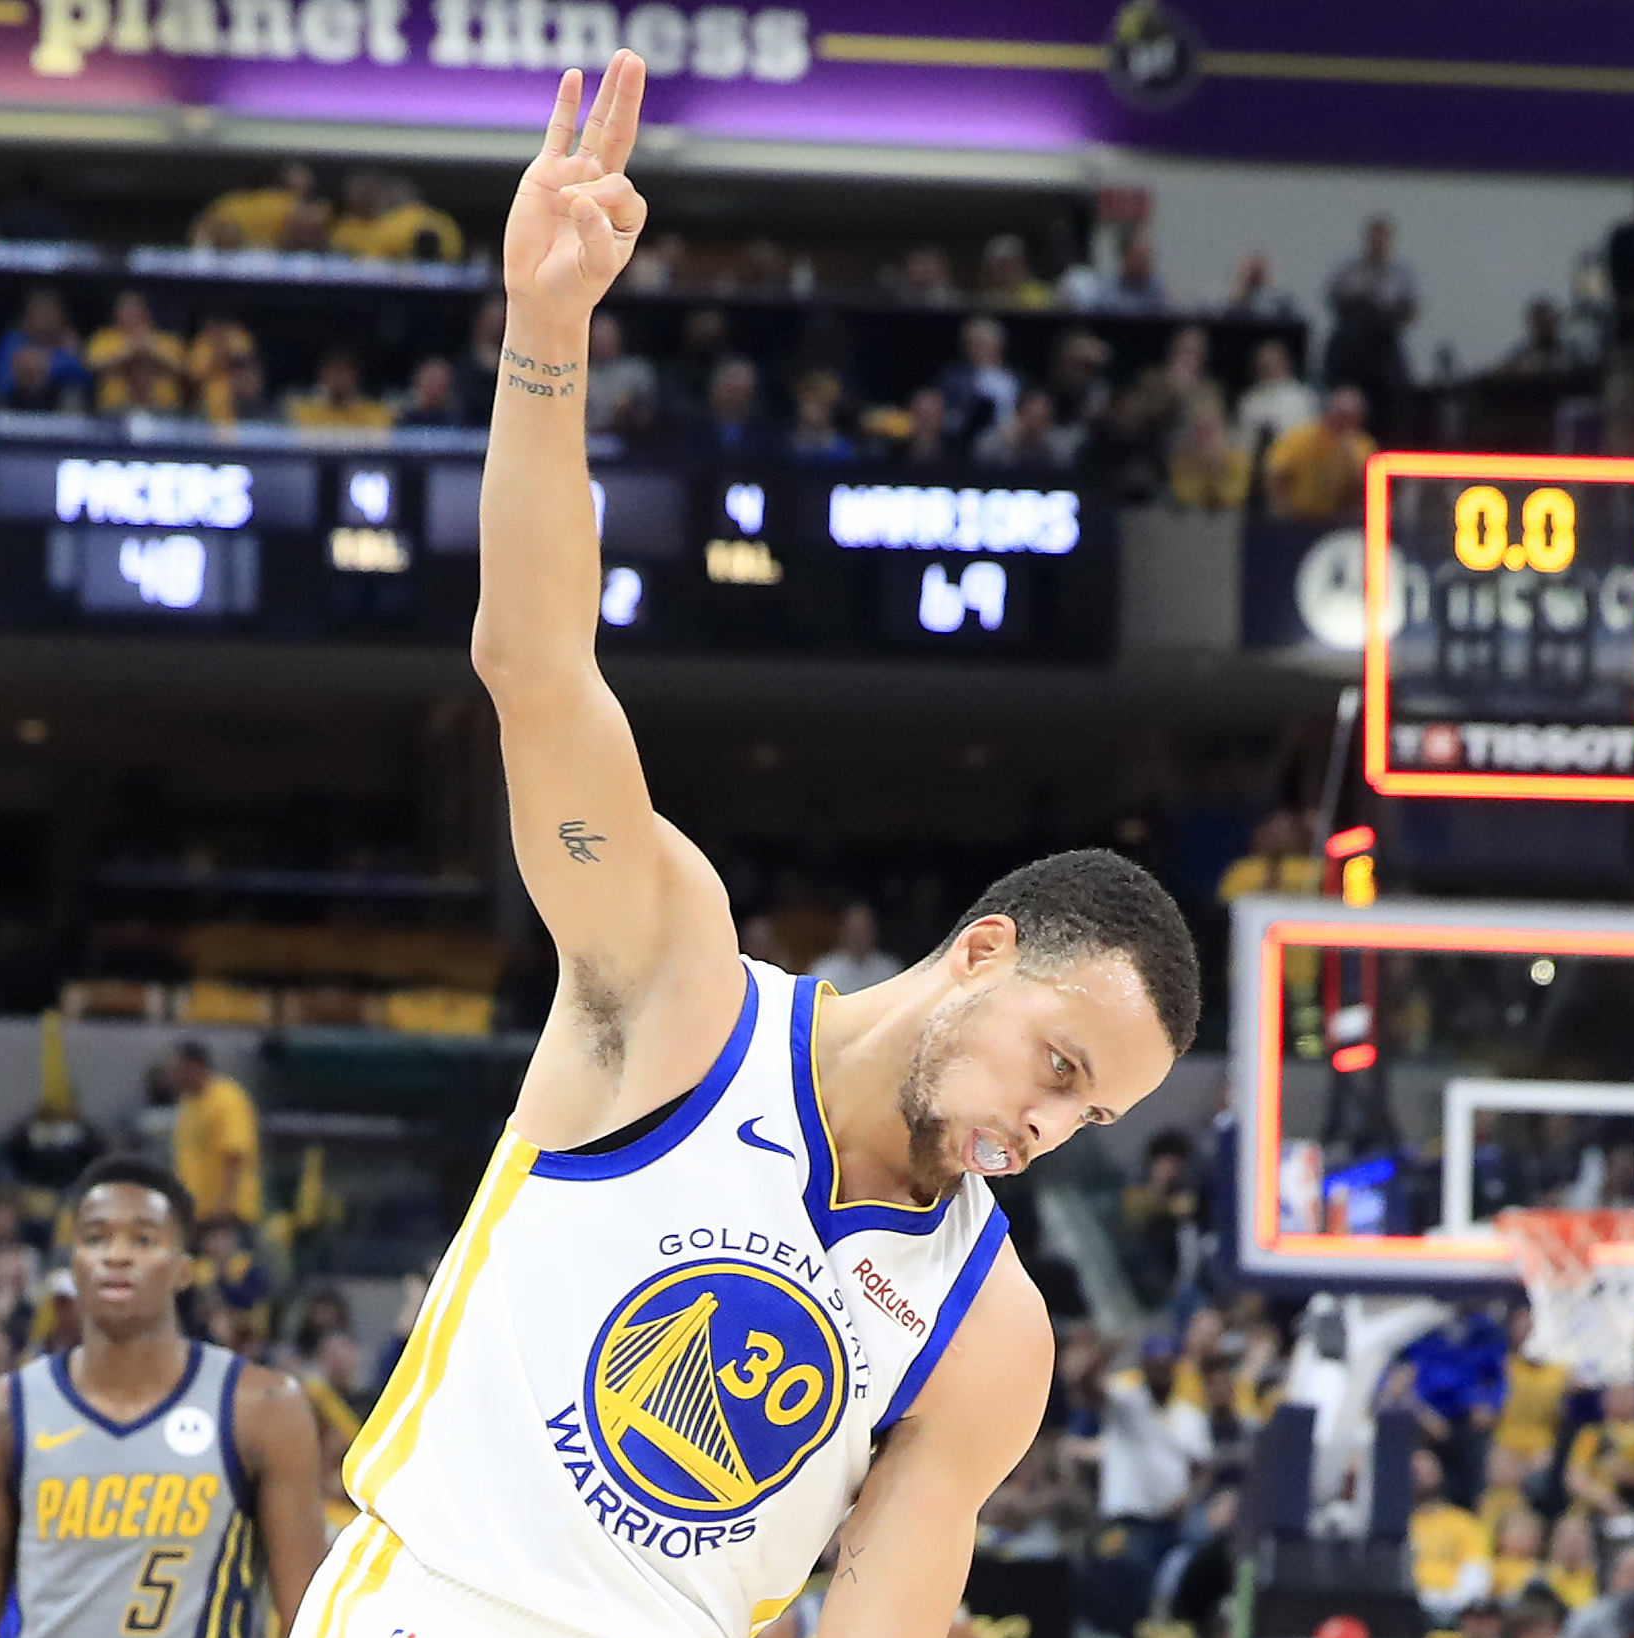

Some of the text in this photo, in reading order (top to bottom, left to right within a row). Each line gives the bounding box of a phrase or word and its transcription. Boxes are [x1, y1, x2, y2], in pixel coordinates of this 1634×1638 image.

[29, 0, 809, 82] planet fitness
[56, 457, 253, 529] PACERS
[829, 482, 1081, 554] WARRIORS
[1455, 485, 1576, 573] 0.0
[919, 559, 1008, 633] 69
[658, 1227, 872, 1400] GOLDEN SATE
[851, 1257, 928, 1339] Rakuten
[716, 1329, 825, 1426] 30
[36, 1472, 221, 1541] PACERS
[545, 1399, 758, 1559] WARRIORS
[121, 1546, 194, 1637] 5
